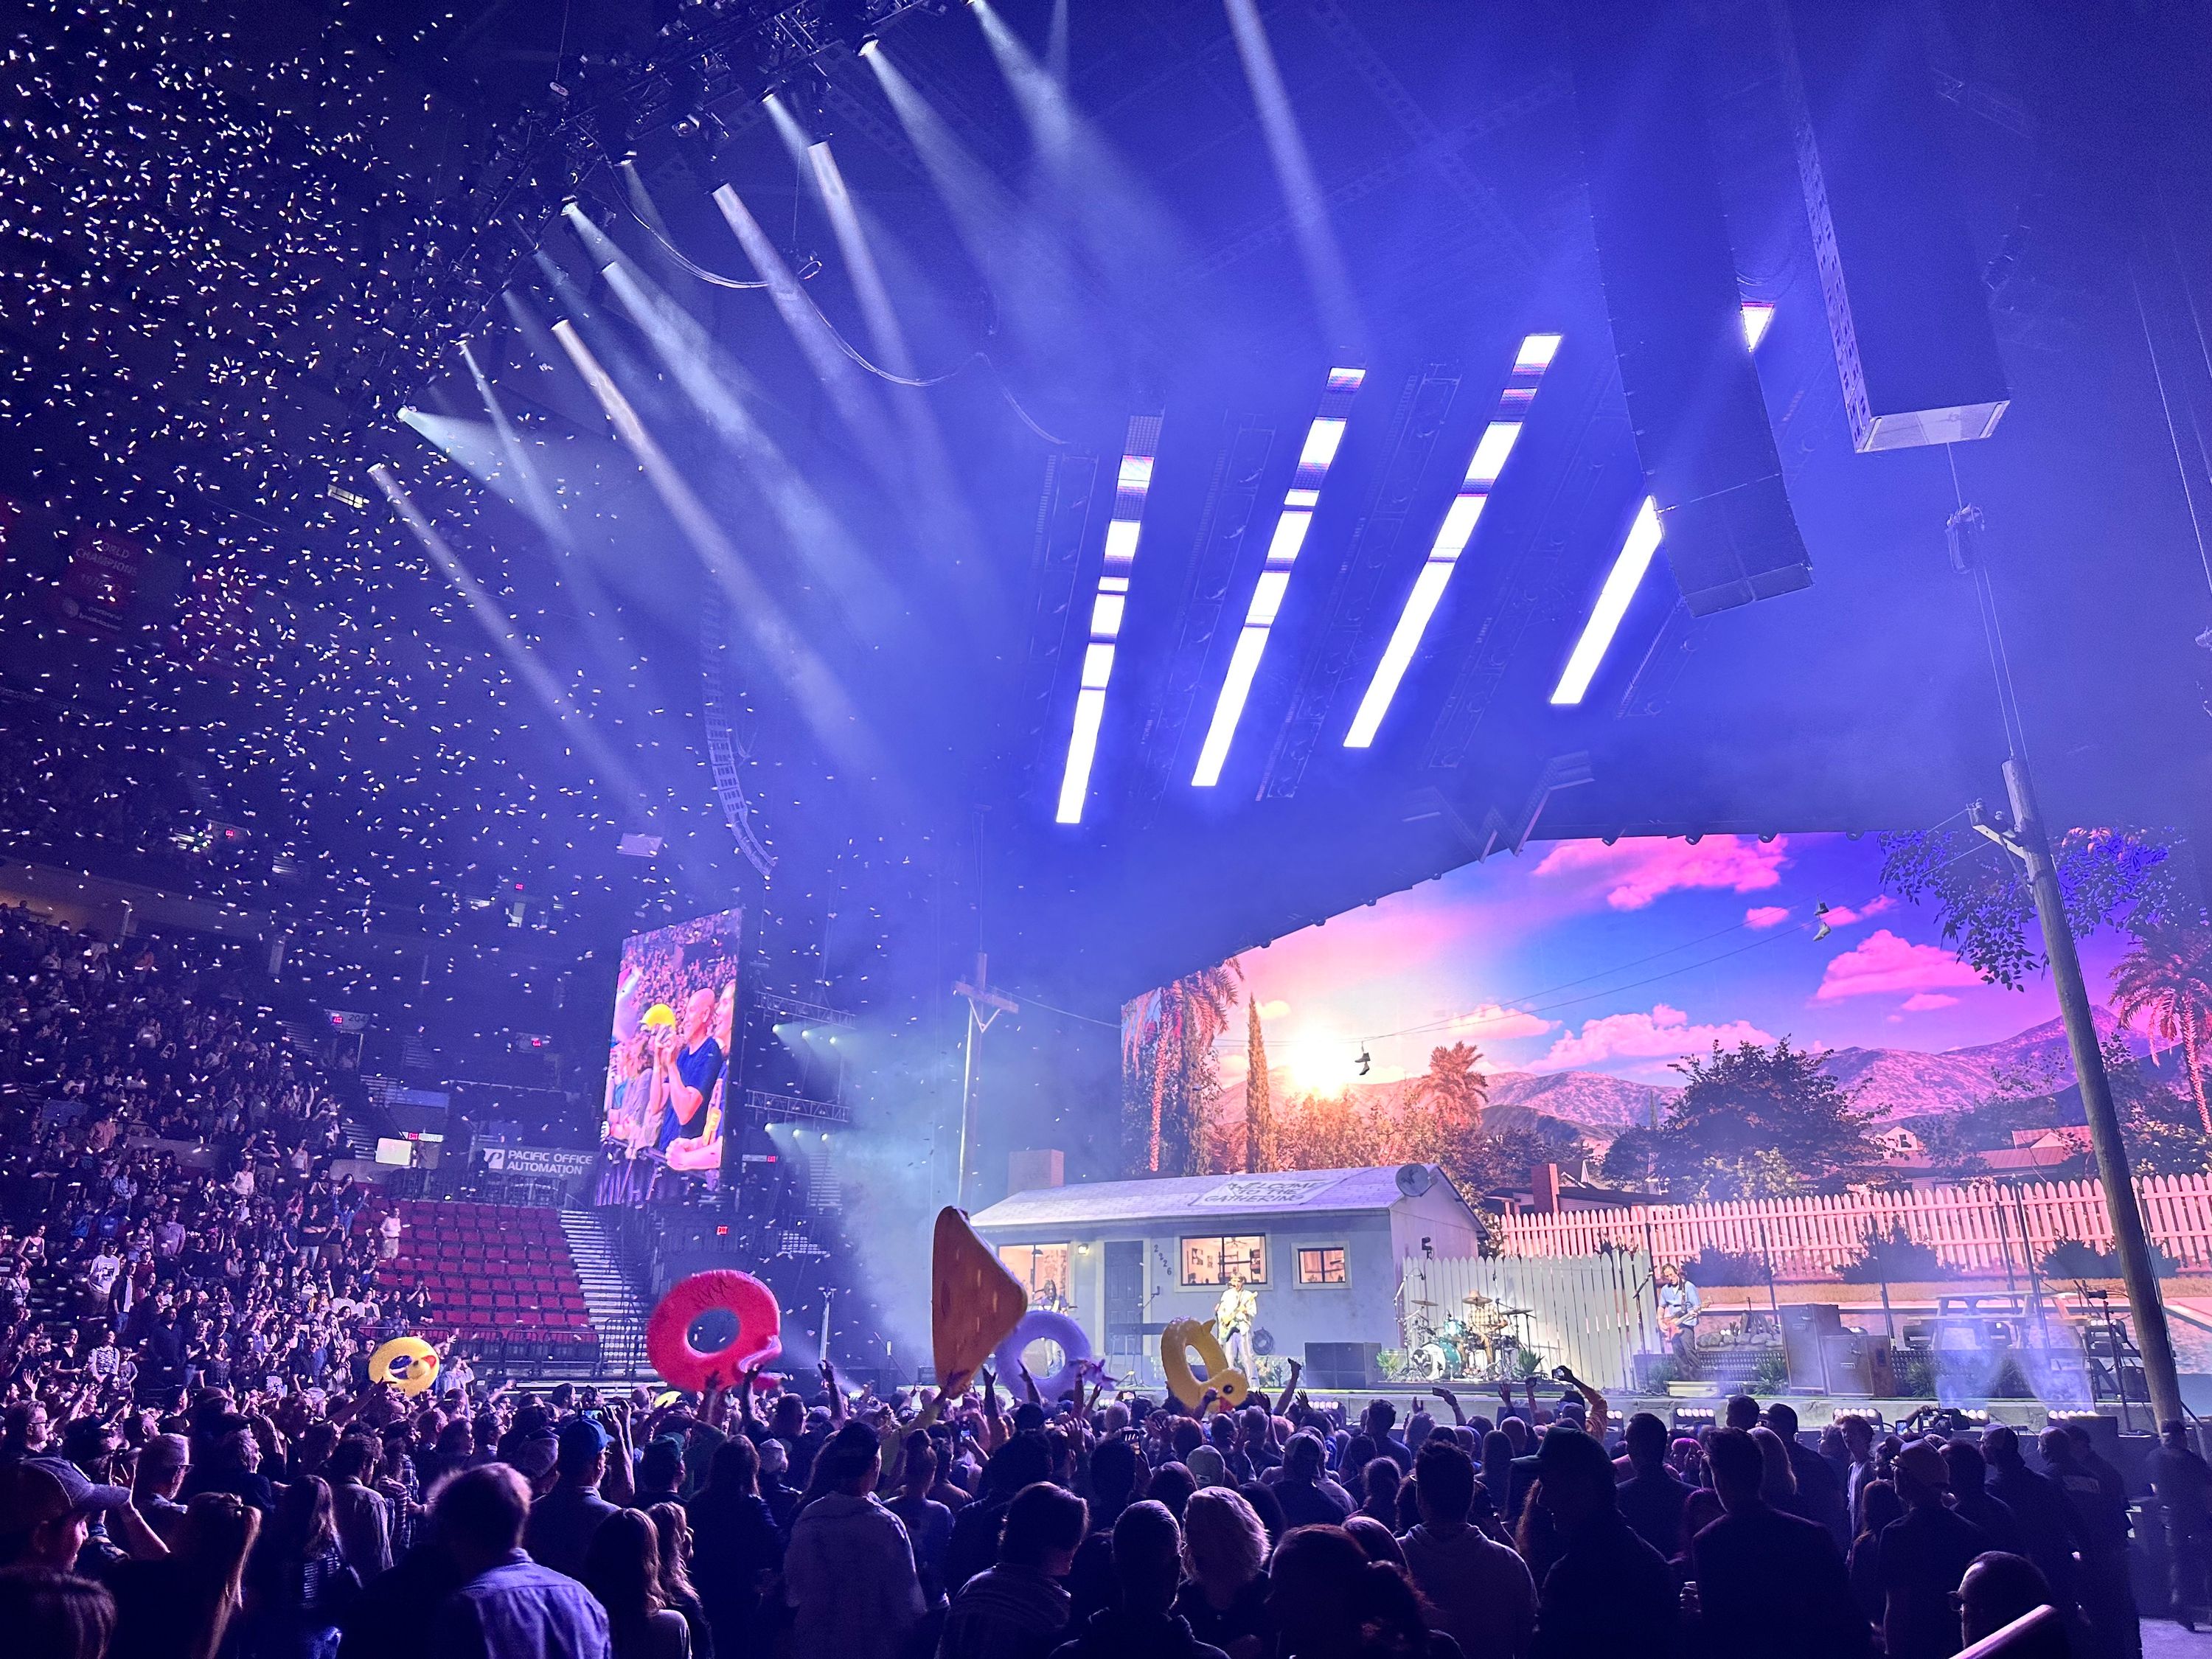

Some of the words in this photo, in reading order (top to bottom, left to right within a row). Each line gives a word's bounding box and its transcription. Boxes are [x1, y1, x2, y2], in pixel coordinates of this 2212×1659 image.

[75, 548, 138, 576] CHAMPIONS
[508, 1150, 549, 1161] PACIFIC
[554, 1153, 593, 1165] OFFICE
[507, 1161, 582, 1174] AUTOMATION
[1228, 1181, 1323, 1190] WELCOME
[1204, 1194, 1304, 1203] GATHERING
[1154, 1244, 1172, 1275] 2226
